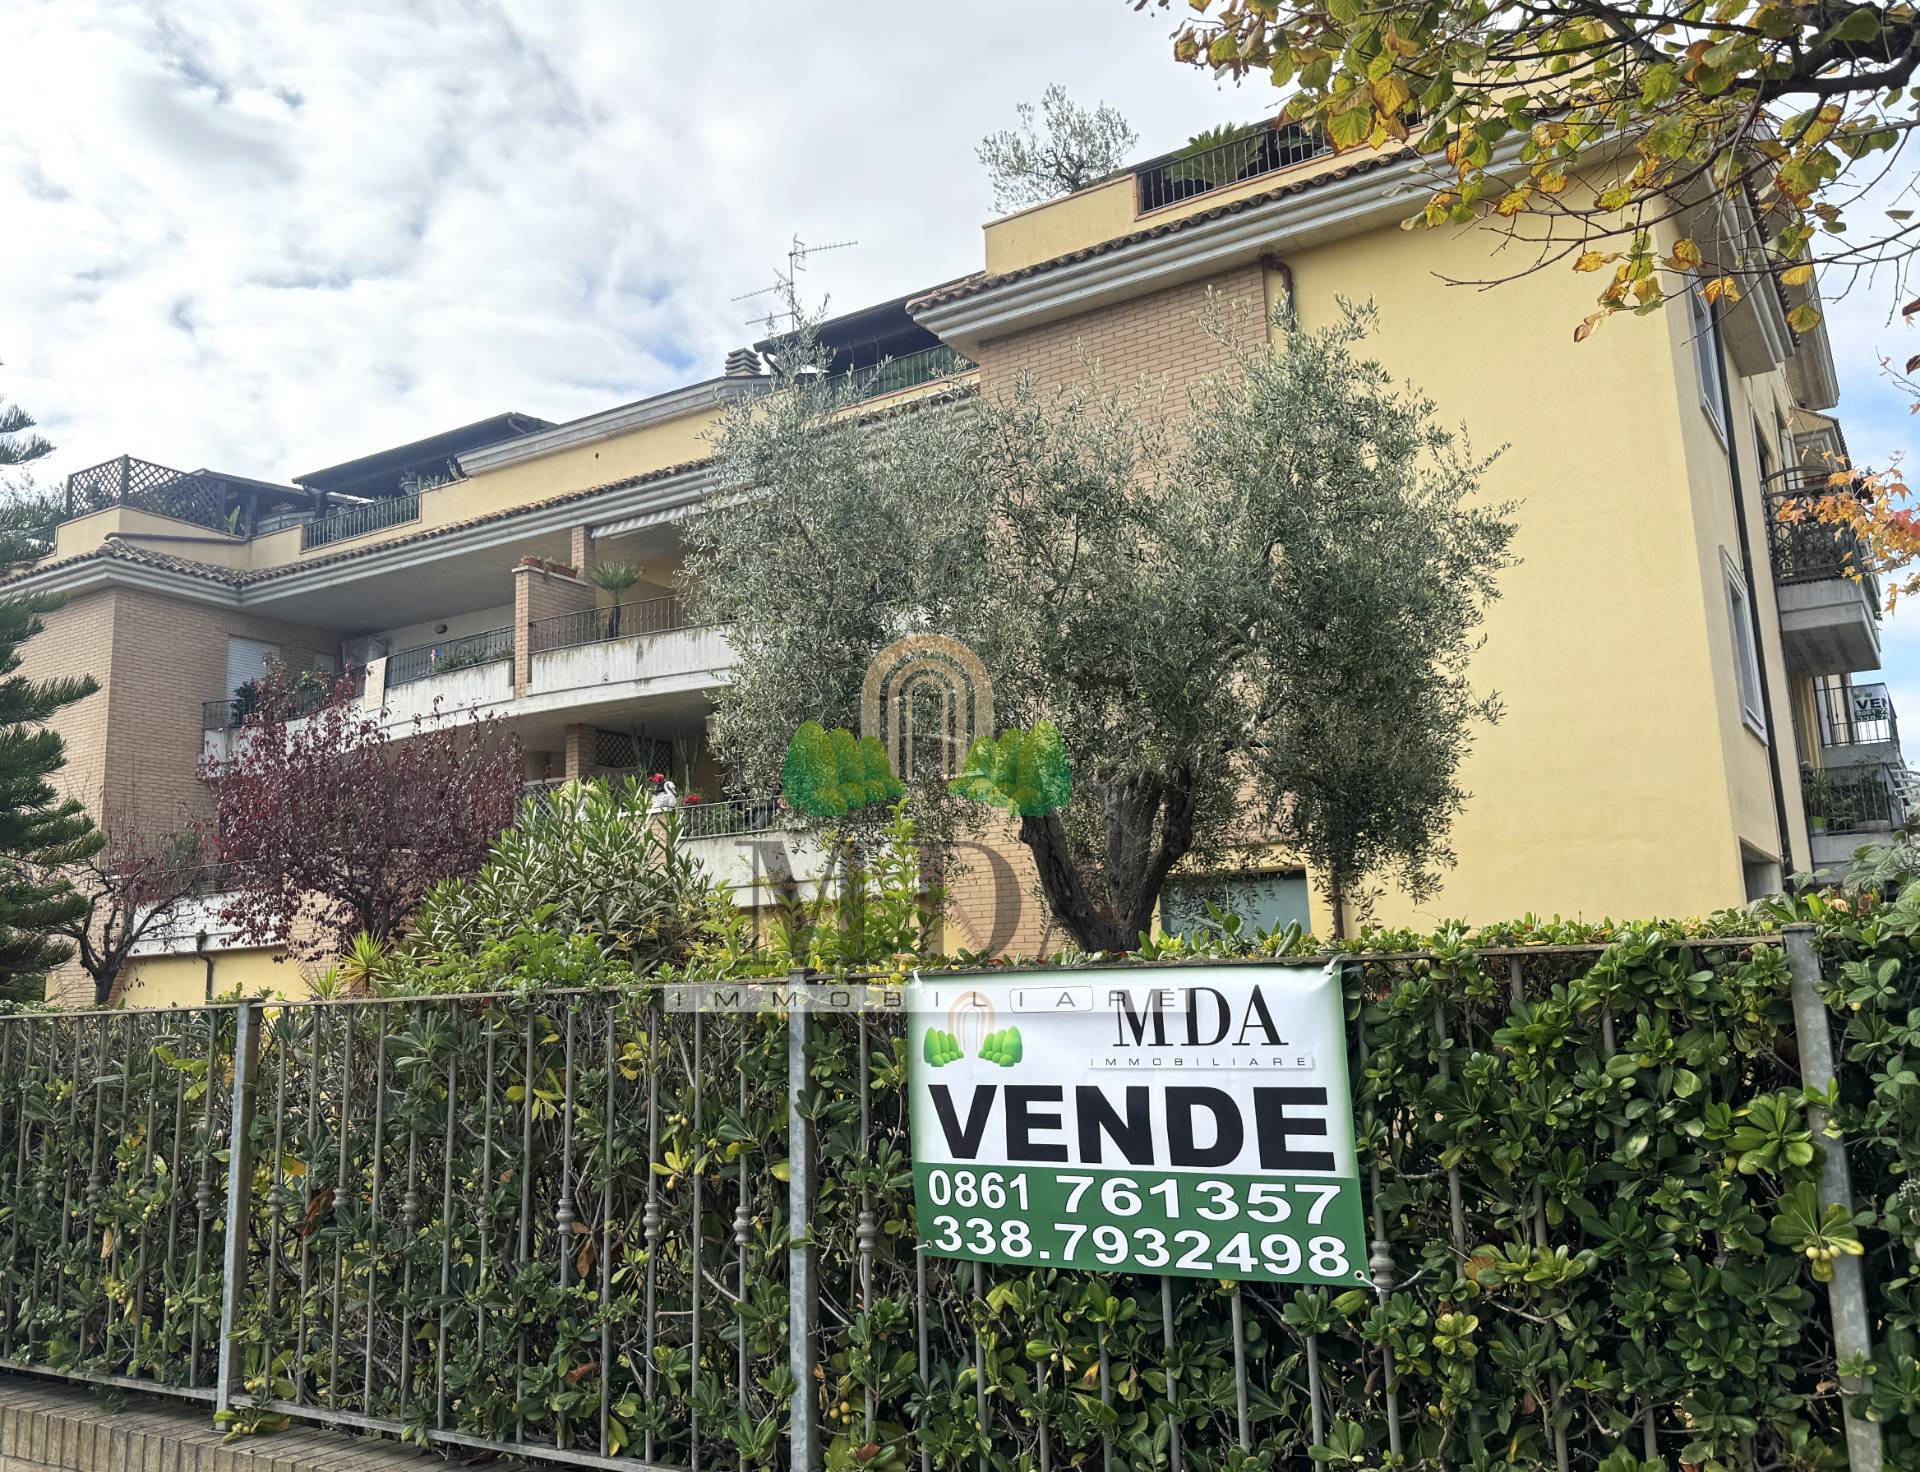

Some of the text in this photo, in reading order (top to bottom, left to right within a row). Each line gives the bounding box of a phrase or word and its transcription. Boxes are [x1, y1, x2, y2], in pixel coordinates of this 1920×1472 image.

[1112, 984, 1289, 1047] MDA
[1091, 1057, 1306, 1066] IMMOBILIARE
[928, 1084, 1336, 1171] VENDE
[928, 1169, 1341, 1225] 0861 761357
[932, 1215, 1351, 1278] 338.7932498
